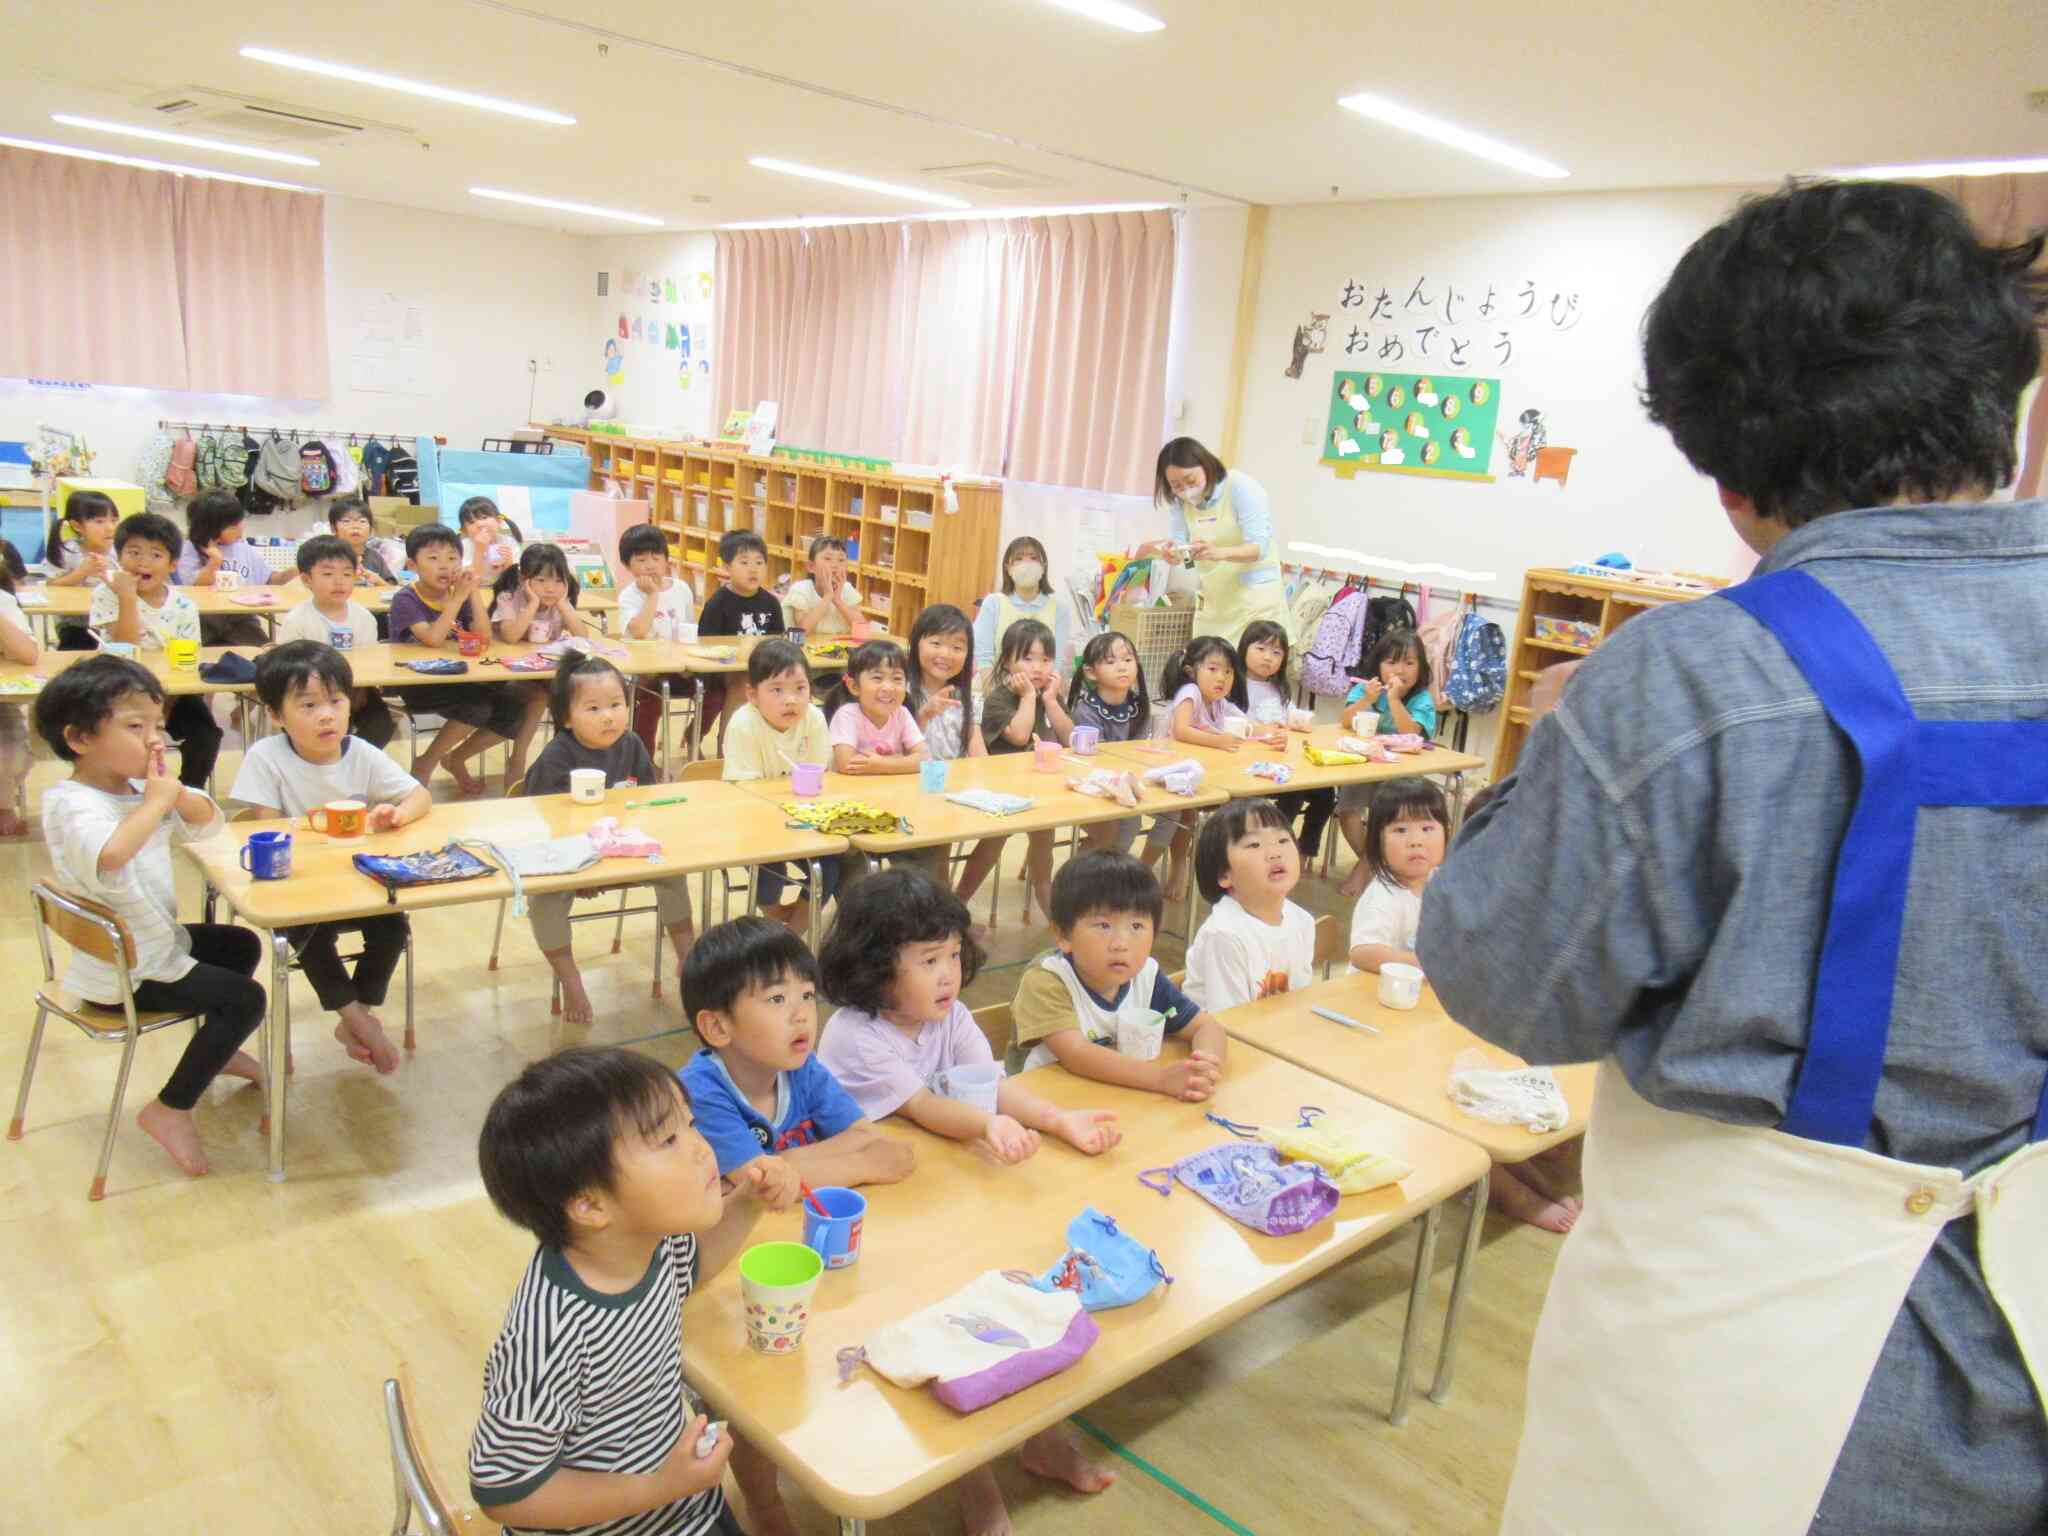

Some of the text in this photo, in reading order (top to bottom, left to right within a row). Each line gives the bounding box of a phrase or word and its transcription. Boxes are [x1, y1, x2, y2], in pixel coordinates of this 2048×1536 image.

[1341, 276, 1579, 326] おたんじょうび
[1345, 325, 1512, 366] おめでとう
